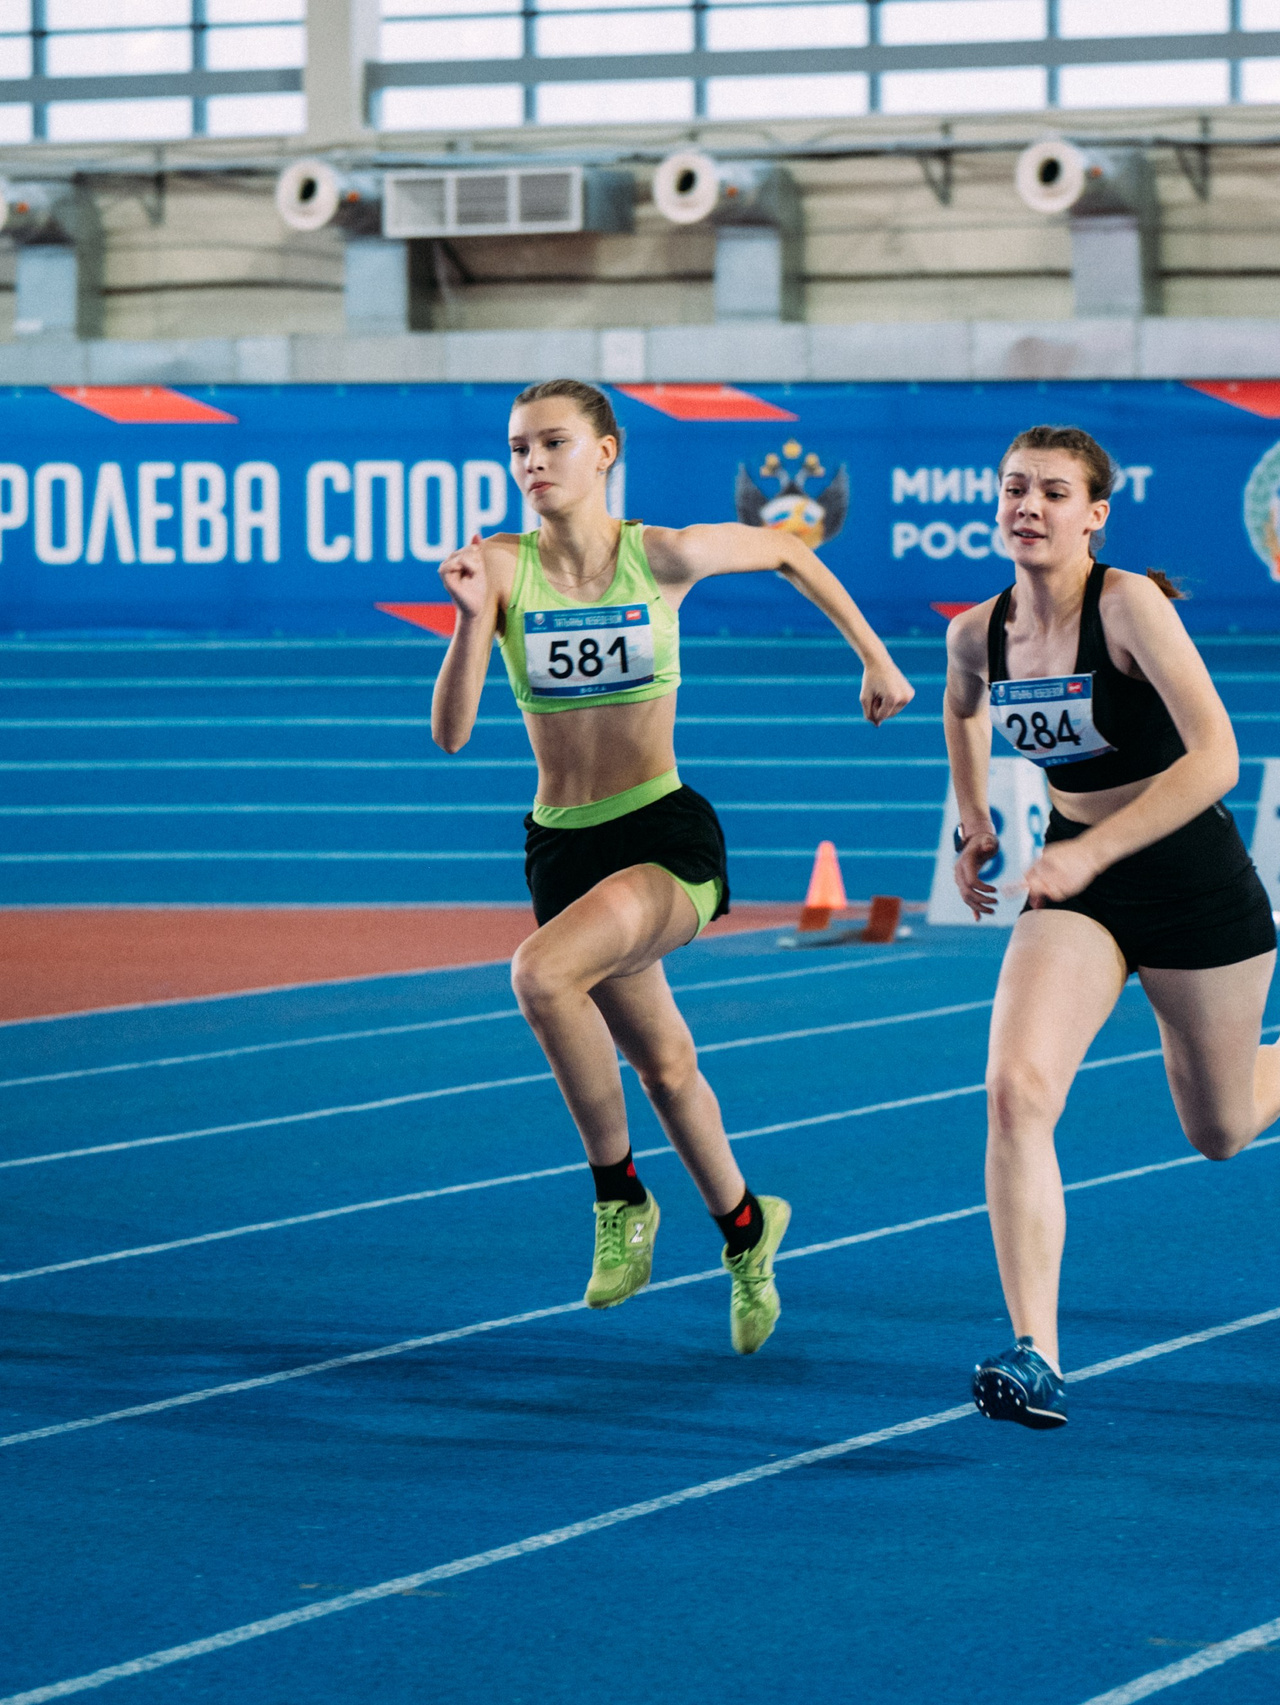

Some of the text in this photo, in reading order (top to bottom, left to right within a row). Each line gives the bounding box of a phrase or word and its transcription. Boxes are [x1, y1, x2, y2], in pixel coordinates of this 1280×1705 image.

[306, 460, 627, 563] СПОР
[548, 636, 629, 680] 581
[1006, 709, 1082, 751] 284
